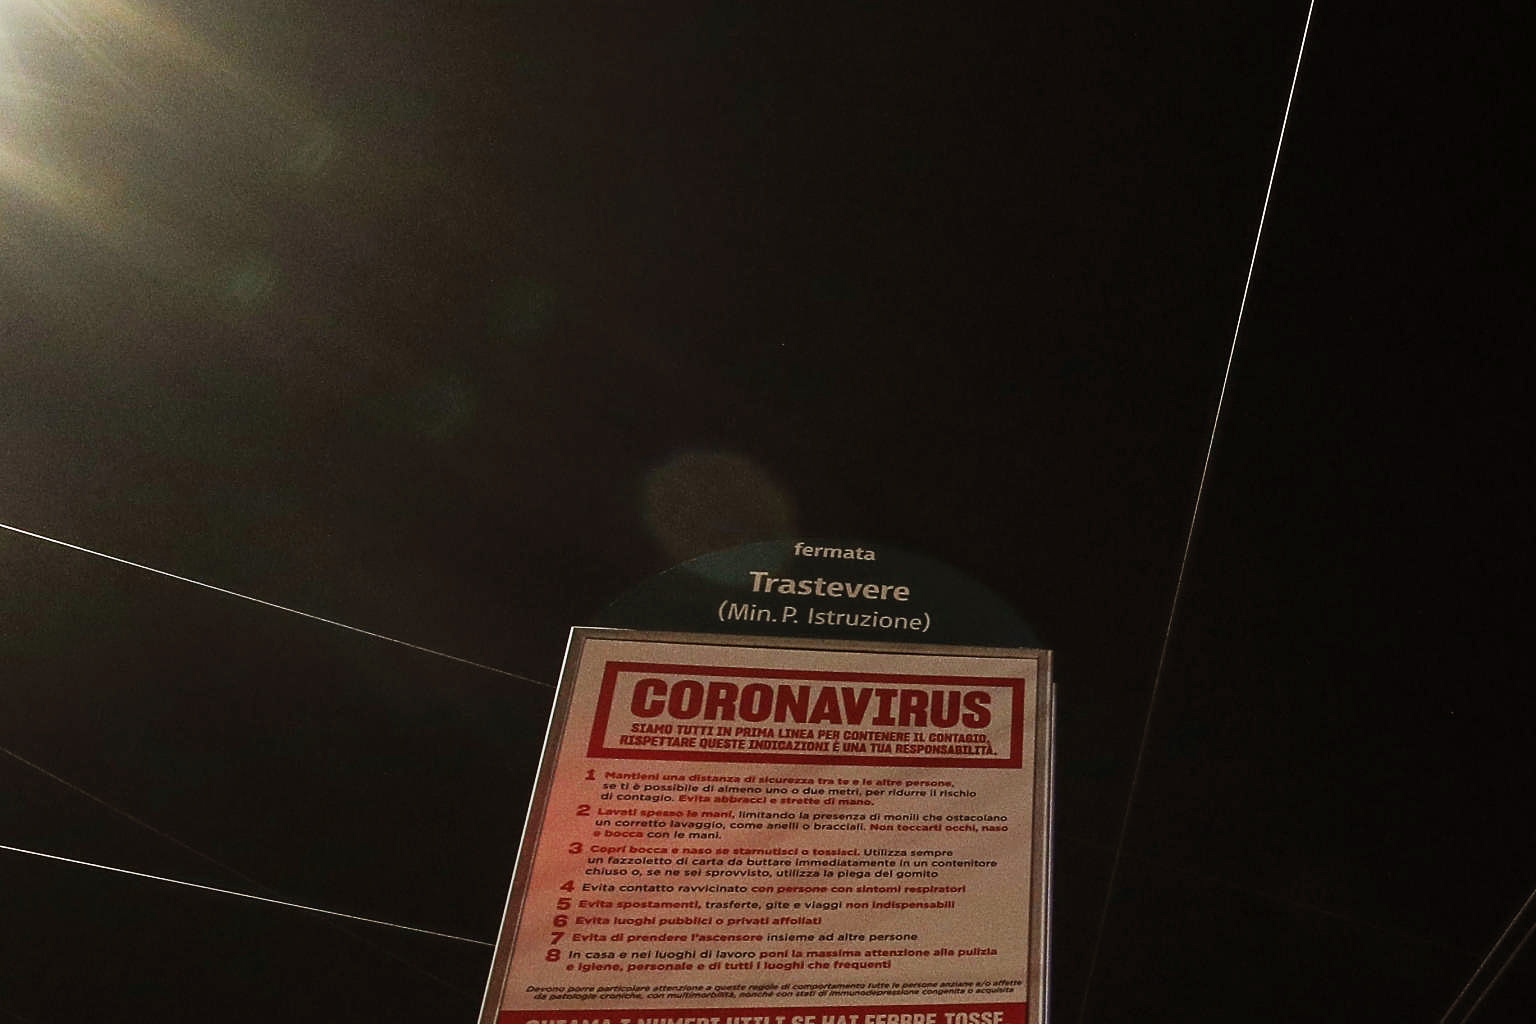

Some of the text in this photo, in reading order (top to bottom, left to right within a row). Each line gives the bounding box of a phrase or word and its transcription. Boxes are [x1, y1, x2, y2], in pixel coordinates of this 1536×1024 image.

[794, 542, 876, 561] fermata
[749, 571, 910, 601] Trastevere
[718, 602, 930, 632] (Min. P. Istruzione)
[630, 678, 991, 728] CORONAVIRUS
[631, 723, 990, 743] SIAMO TUTTI IN PRIMA LINEA PER CONTENERE IL CONTAGIO.
[620, 735, 997, 756] RISPETTARE QUESTE INDICAZIONI È UNA TUA RESPONSABILITÀ.
[644, 783, 699, 793] possibile
[702, 784, 714, 792] di
[718, 786, 762, 794] almeno
[803, 788, 825, 796] due
[828, 788, 862, 796] metri,
[888, 789, 926, 797] ridurre
[940, 790, 976, 798] rischio
[576, 805, 591, 816] 2
[598, 808, 636, 816] Lavati
[640, 810, 684, 819] spesso
[701, 810, 735, 819] mani,
[739, 811, 795, 819] limitando
[800, 812, 809, 820] la
[813, 814, 866, 822] presenza
[870, 813, 880, 821] di
[946, 814, 1008, 822] ostacolano
[670, 820, 725, 830] lavaggio,
[767, 822, 799, 830] anelli
[814, 823, 866, 831] bracciali.
[945, 824, 978, 833] occhi,
[604, 830, 643, 838] bocca
[647, 831, 670, 839] con
[674, 831, 685, 839] le
[608, 857, 672, 865] fazzoletto
[747, 858, 791, 866] buttare
[795, 859, 896, 867] immediatamente
[900, 859, 910, 867] in
[585, 868, 628, 876] chiuso
[684, 869, 701, 877] sei
[705, 869, 772, 878] sprovvisto,
[777, 870, 820, 878] utilizza
[824, 870, 834, 878] la
[838, 870, 870, 879] piega
[874, 870, 893, 878] del
[897, 870, 938, 879] gomito
[560, 881, 575, 892] 4
[619, 884, 674, 892] contatto
[678, 884, 747, 893] ravvicinato
[777, 886, 828, 894] persone
[856, 885, 900, 893] sintomi
[904, 885, 966, 895] respiratori
[557, 898, 572, 910] 5
[578, 900, 613, 908] Evita
[617, 901, 702, 911] spostamenti,
[705, 901, 761, 909] trasferte,
[765, 901, 790, 910] gite
[804, 901, 842, 910] viaggi
[872, 901, 955, 910] indispensabili
[553, 915, 569, 927] 6
[576, 916, 610, 925] Evita
[613, 916, 656, 927] luoghi
[659, 917, 712, 926] pubblici
[727, 917, 769, 926] privati
[772, 916, 822, 925] affollati
[550, 932, 918, 945] 7 Evita di prendere l'ascensore insieme ad altre persone
